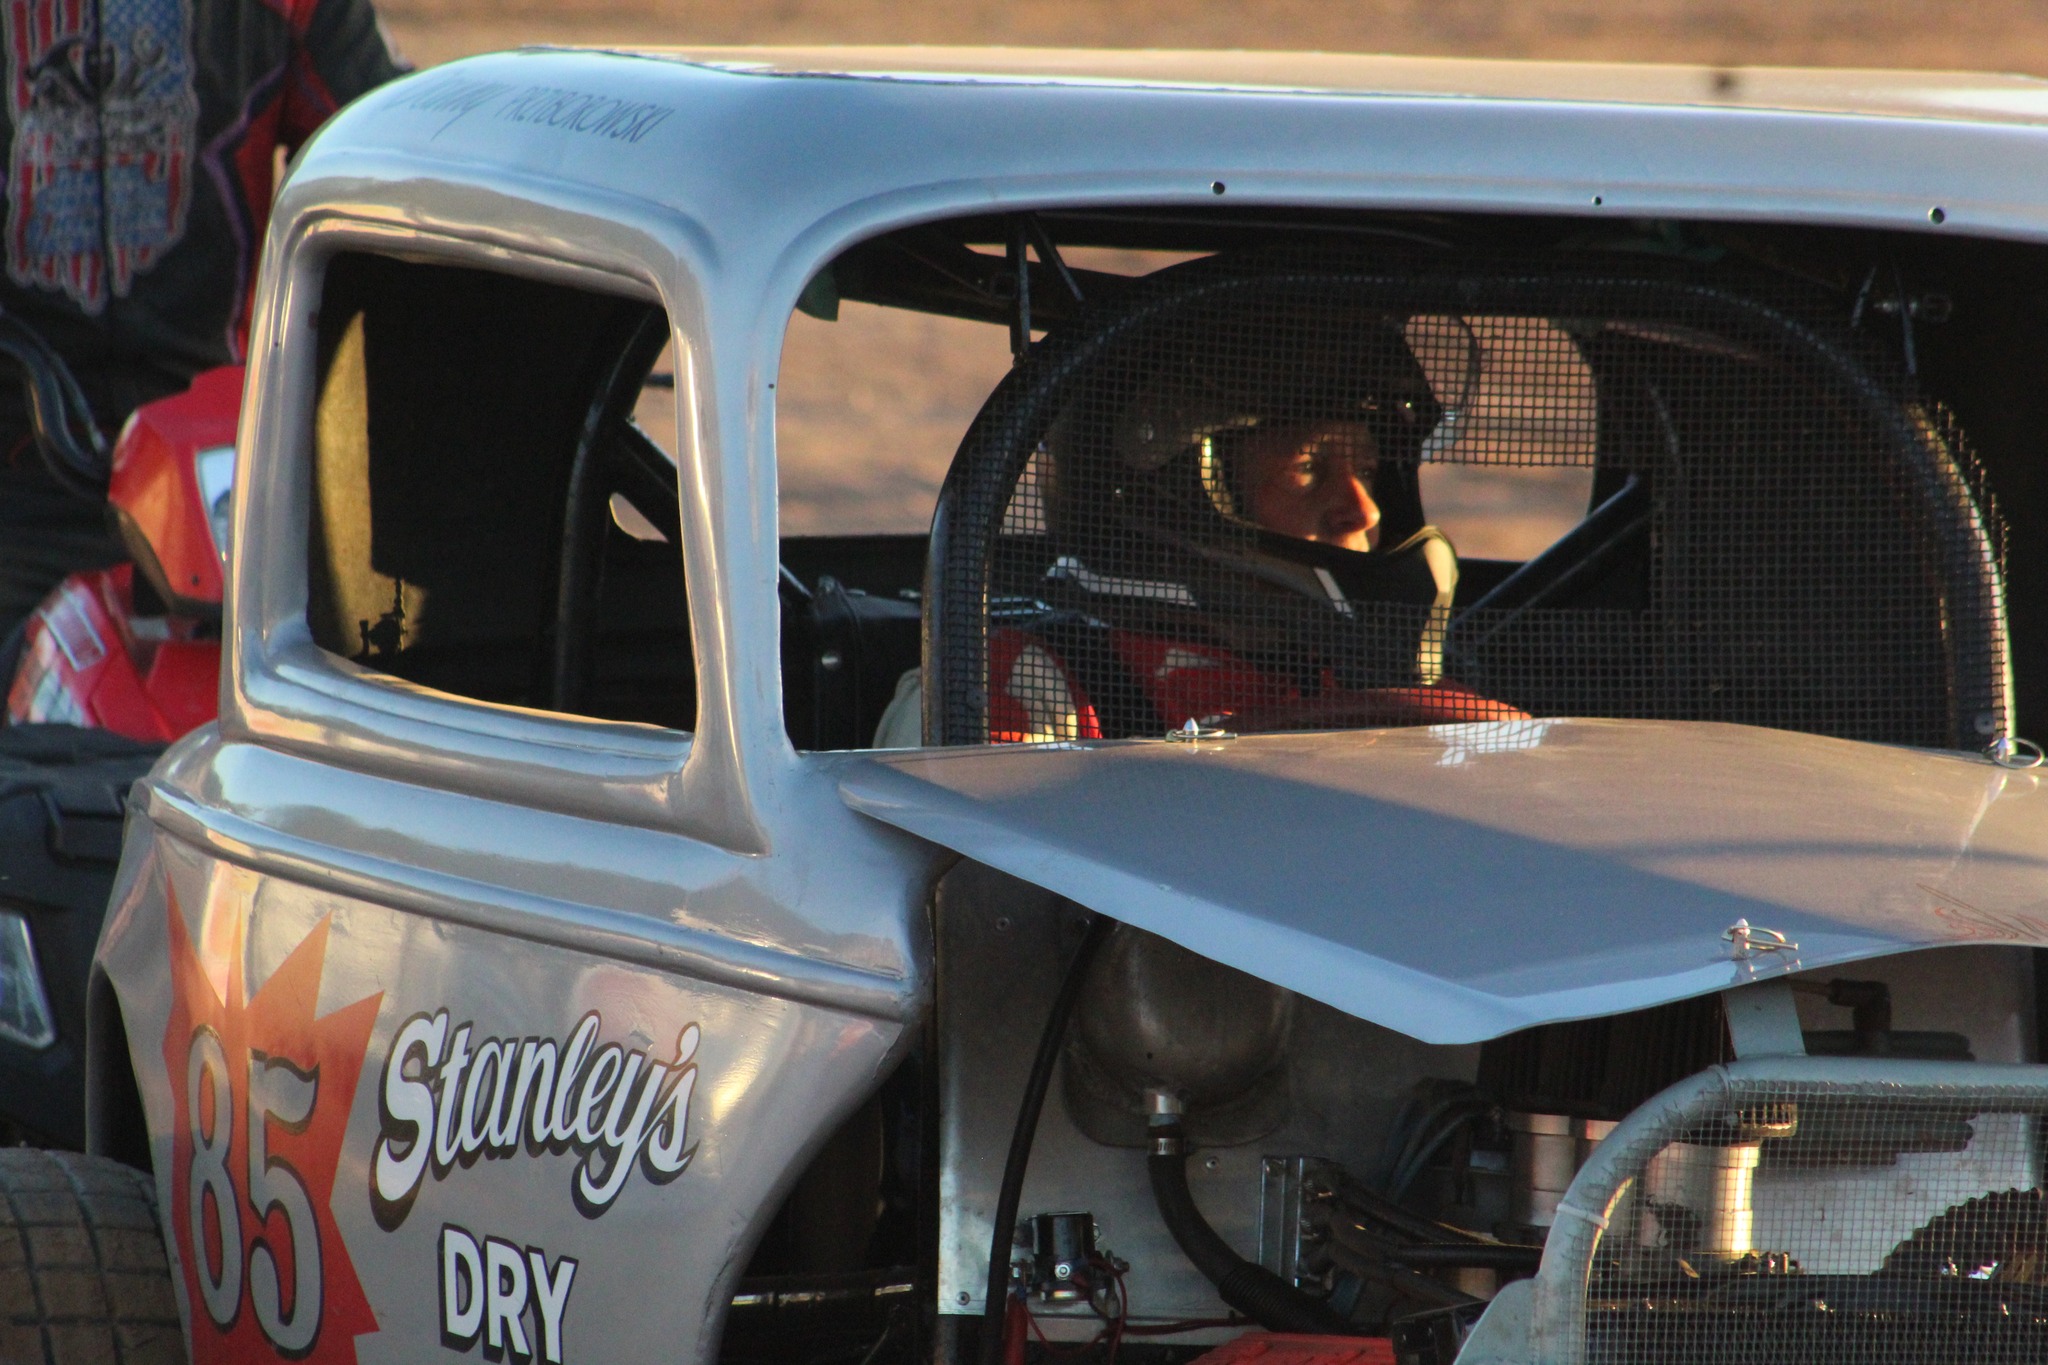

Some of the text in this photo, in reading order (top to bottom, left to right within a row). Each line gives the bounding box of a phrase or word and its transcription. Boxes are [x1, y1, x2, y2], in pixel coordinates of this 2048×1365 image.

[187, 1023, 323, 1359] 85
[369, 1006, 701, 1232] Stanley's
[437, 1222, 579, 1365] DRY
